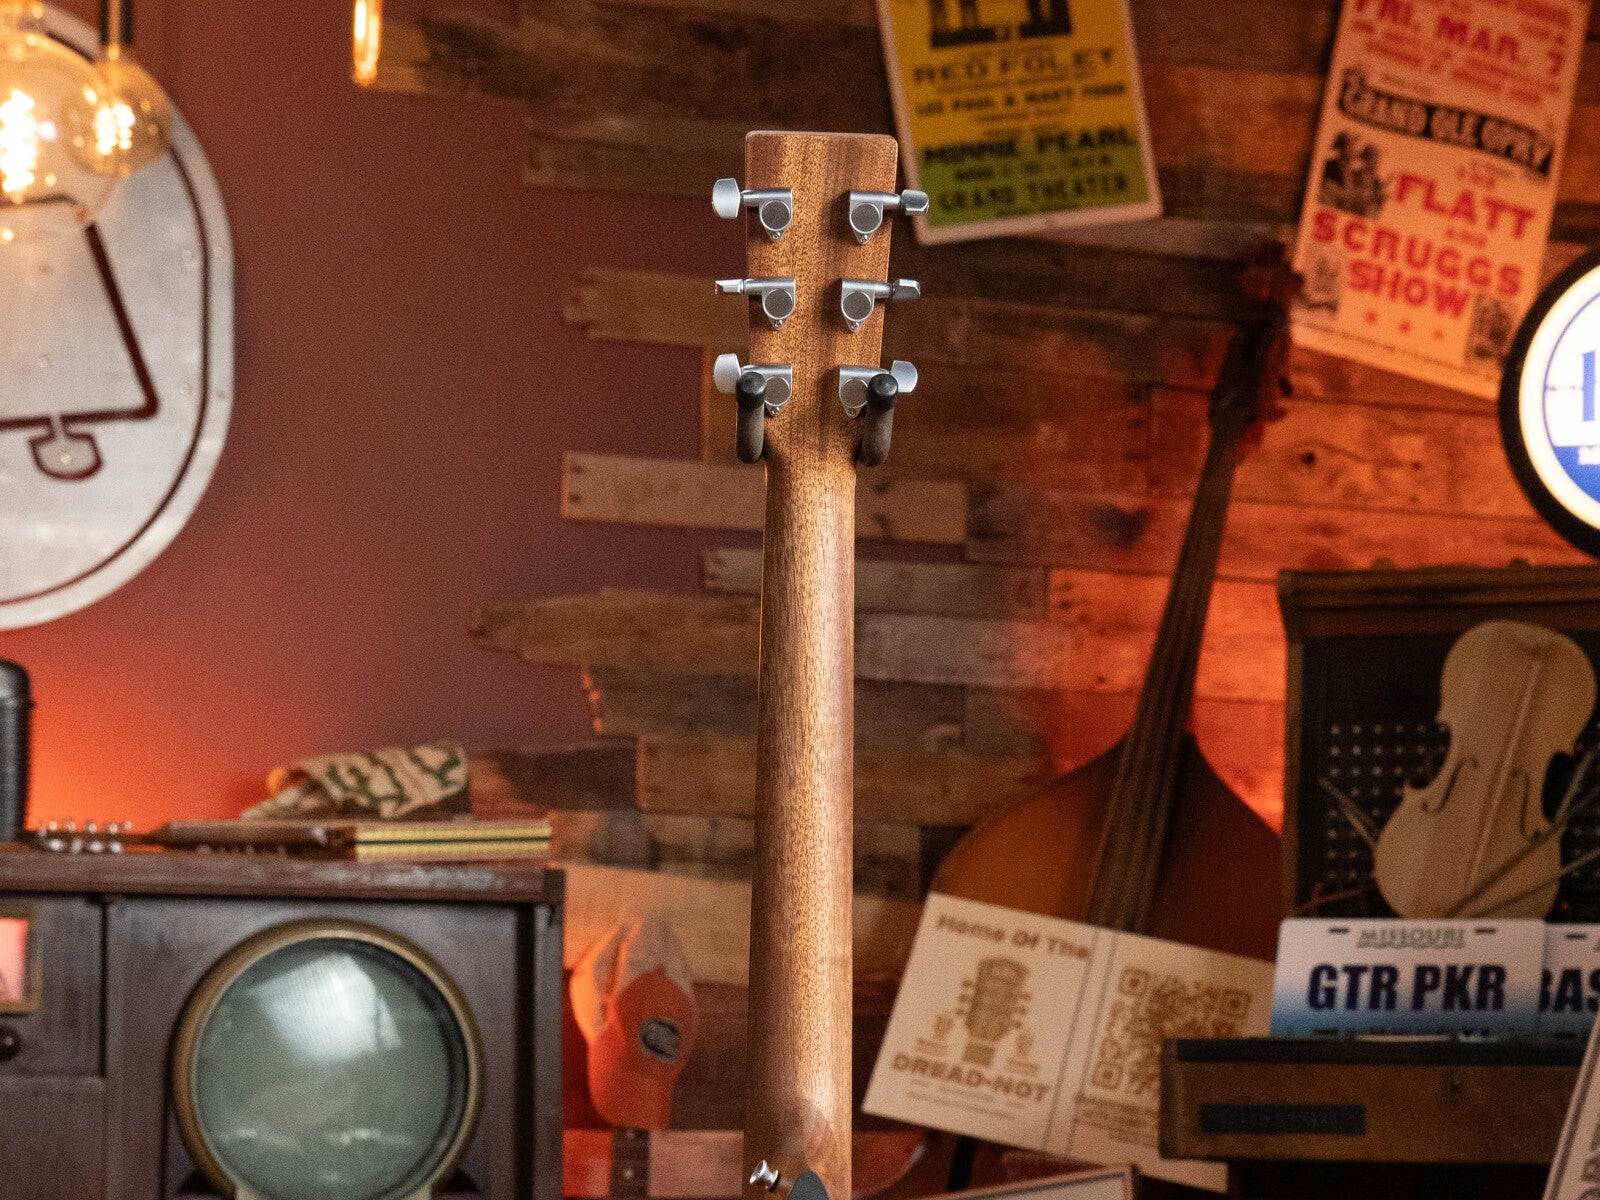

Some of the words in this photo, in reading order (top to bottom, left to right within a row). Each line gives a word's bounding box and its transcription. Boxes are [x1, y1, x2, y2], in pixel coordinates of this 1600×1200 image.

[999, 47, 1114, 73] FOLEY
[1436, 16, 1528, 66] MAR.
[1036, 126, 1135, 153] PEARL
[1431, 106, 1477, 146] OLE
[1481, 115, 1556, 175] OPRY
[1395, 172, 1535, 239] FLATT
[1312, 208, 1524, 297] SCRUGGS
[1349, 259, 1471, 319] SHOW
[936, 913, 1005, 942] Home
[1357, 927, 1466, 946] MISSOURI
[1308, 963, 1399, 1011] GTR
[1410, 963, 1507, 1012] PKR
[891, 1051, 1052, 1103] DREAD-NOT
